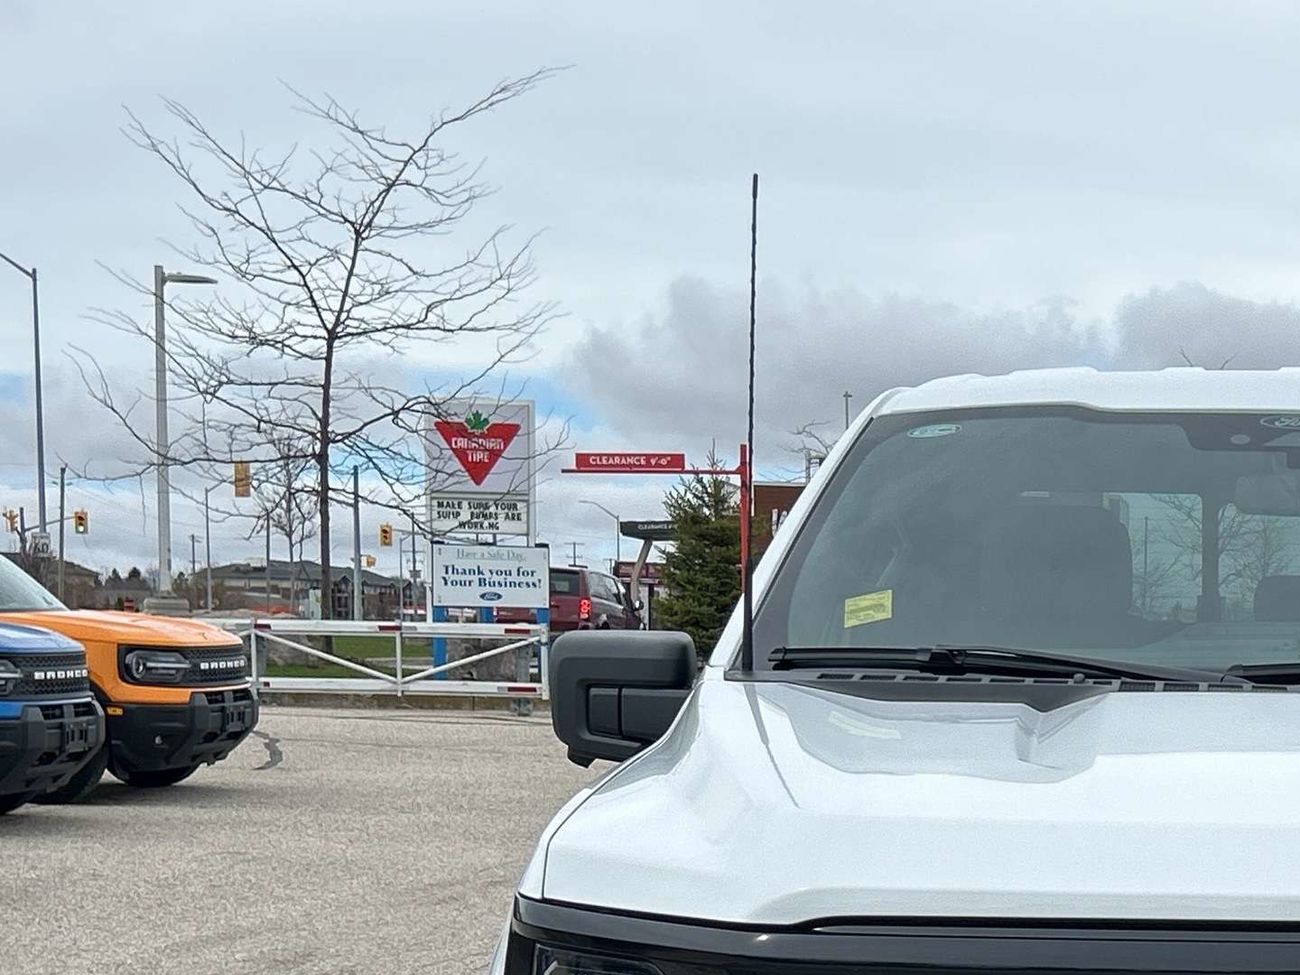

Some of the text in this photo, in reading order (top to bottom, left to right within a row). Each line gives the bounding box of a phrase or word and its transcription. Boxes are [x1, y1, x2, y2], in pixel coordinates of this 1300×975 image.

[451, 437, 504, 450] CANADIAN
[467, 450, 490, 462] TIRE
[589, 456, 646, 465] CLEARANCE
[437, 501, 462, 509] MAKE
[495, 502, 518, 511] YOUR
[504, 512, 522, 521] ARE
[443, 564, 536, 578] Thank you for
[441, 576, 542, 589] Your Business!
[483, 592, 500, 600] Ford
[200, 660, 245, 670] BRONCO
[34, 669, 88, 680] BRONCO
